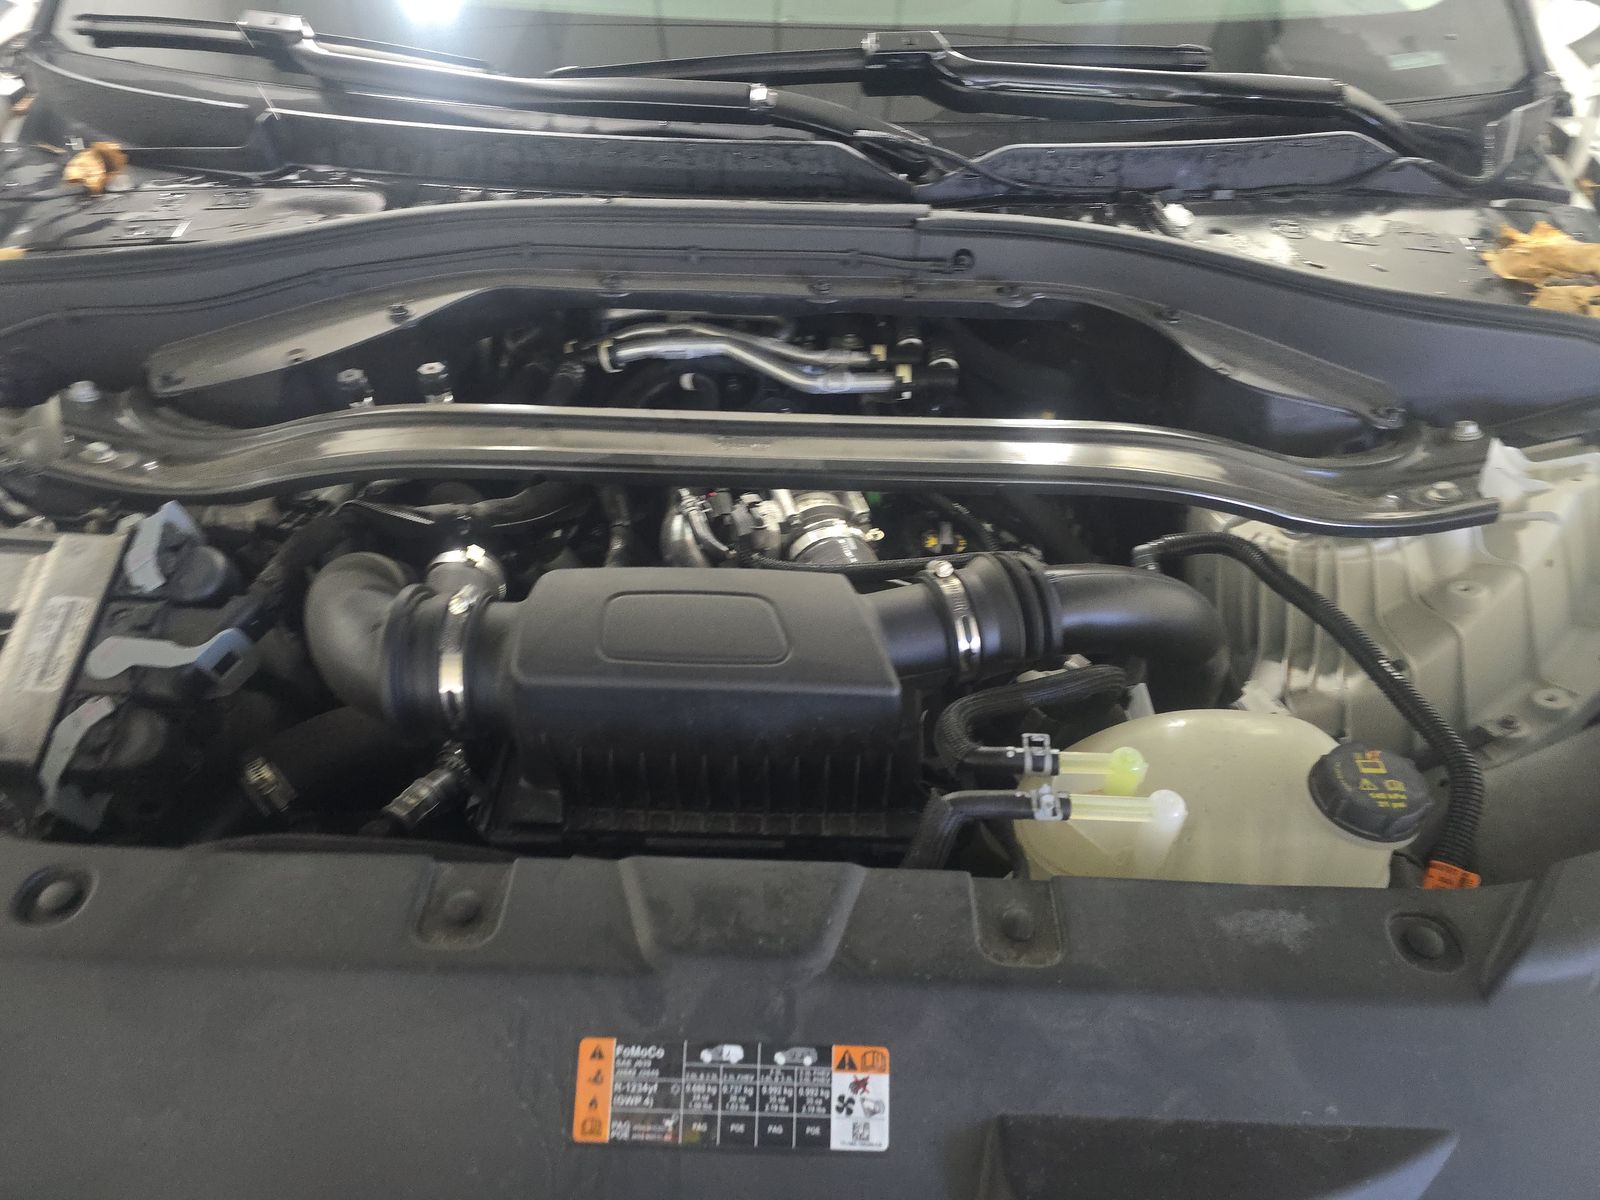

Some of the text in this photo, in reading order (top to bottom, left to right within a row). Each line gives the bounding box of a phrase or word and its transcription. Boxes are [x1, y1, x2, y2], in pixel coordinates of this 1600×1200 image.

[615, 1044, 665, 1059] FoMoCo
[743, 1086, 754, 1097] kg
[783, 1086, 793, 1098] kg
[820, 1088, 831, 1099] kg
[767, 1124, 783, 1134] PAG
